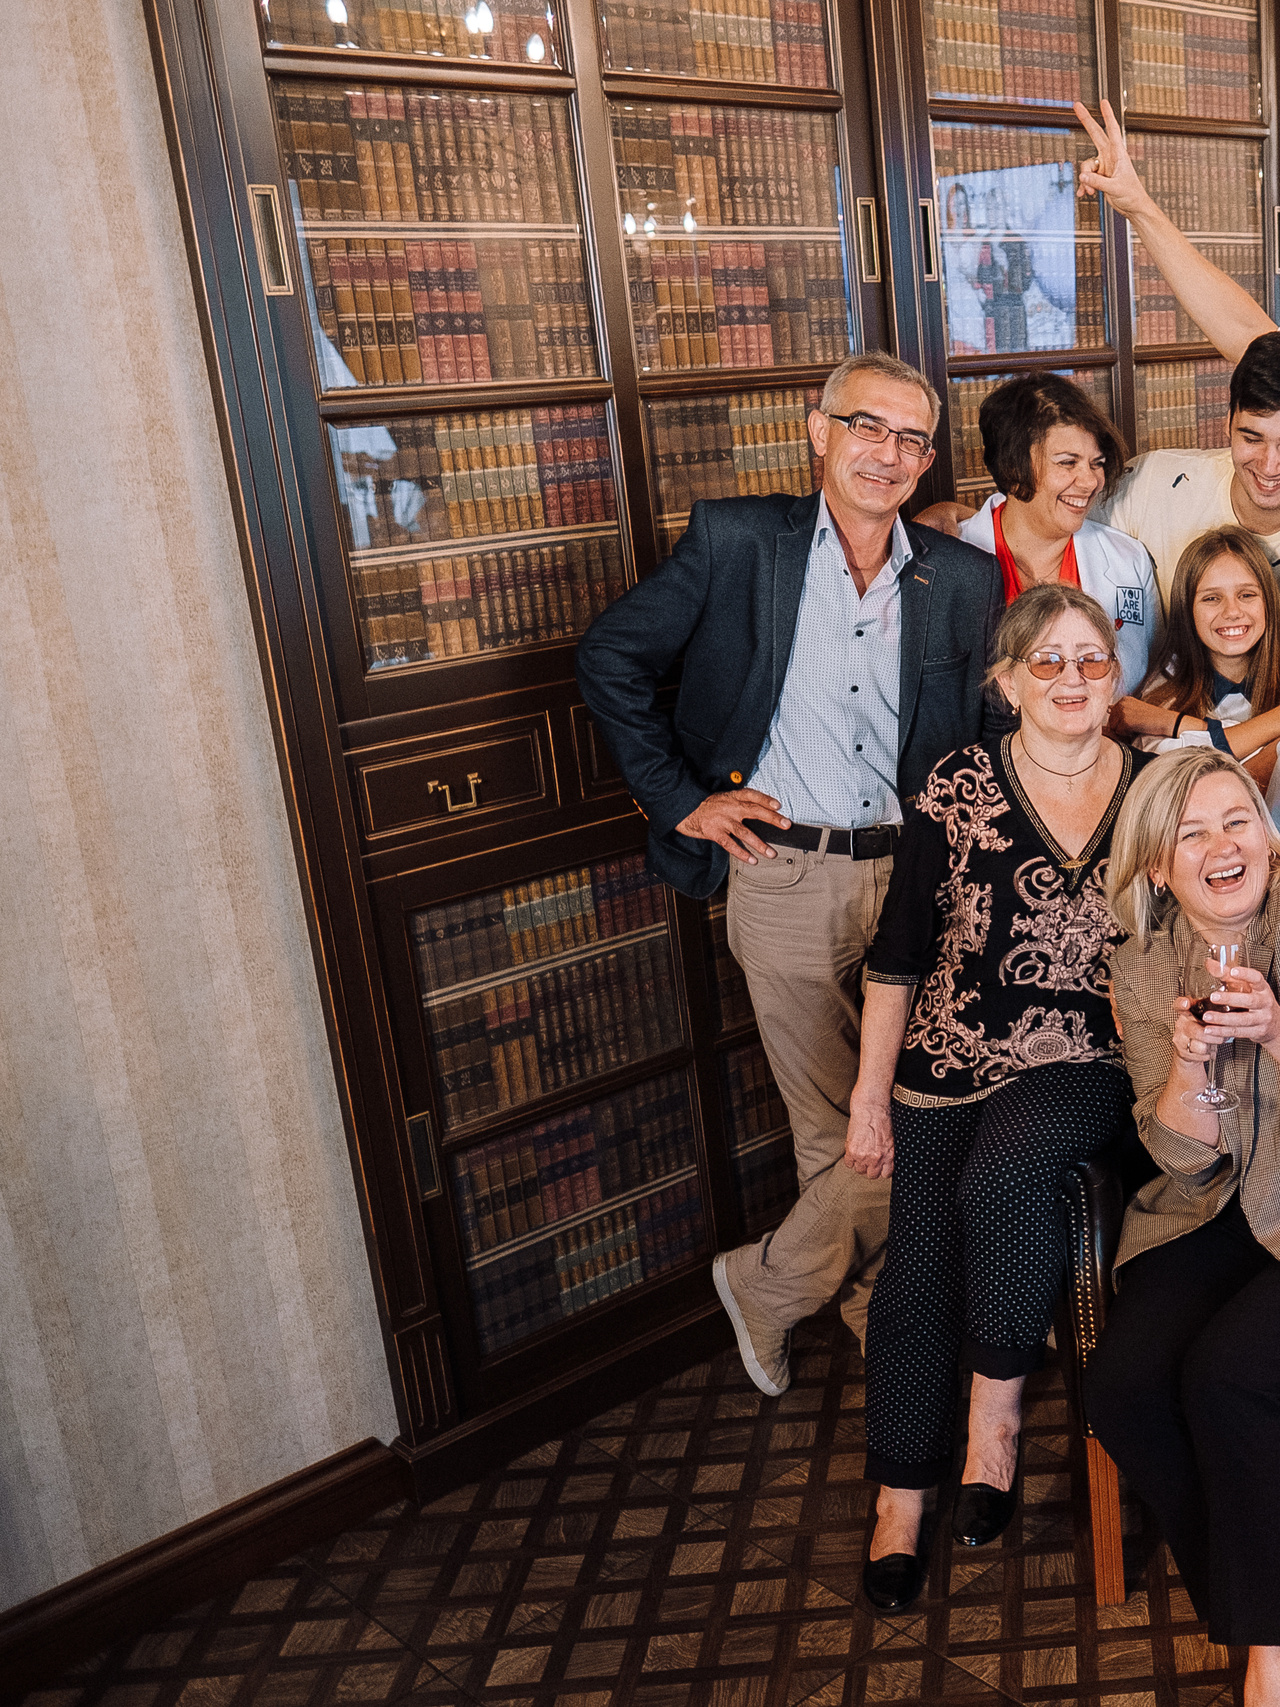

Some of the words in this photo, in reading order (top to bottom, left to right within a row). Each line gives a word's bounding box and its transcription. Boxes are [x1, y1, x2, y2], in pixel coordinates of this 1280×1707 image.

[1121, 589, 1140, 600] YOU
[1123, 599, 1140, 611] ARE
[1120, 610, 1143, 622] COOL
